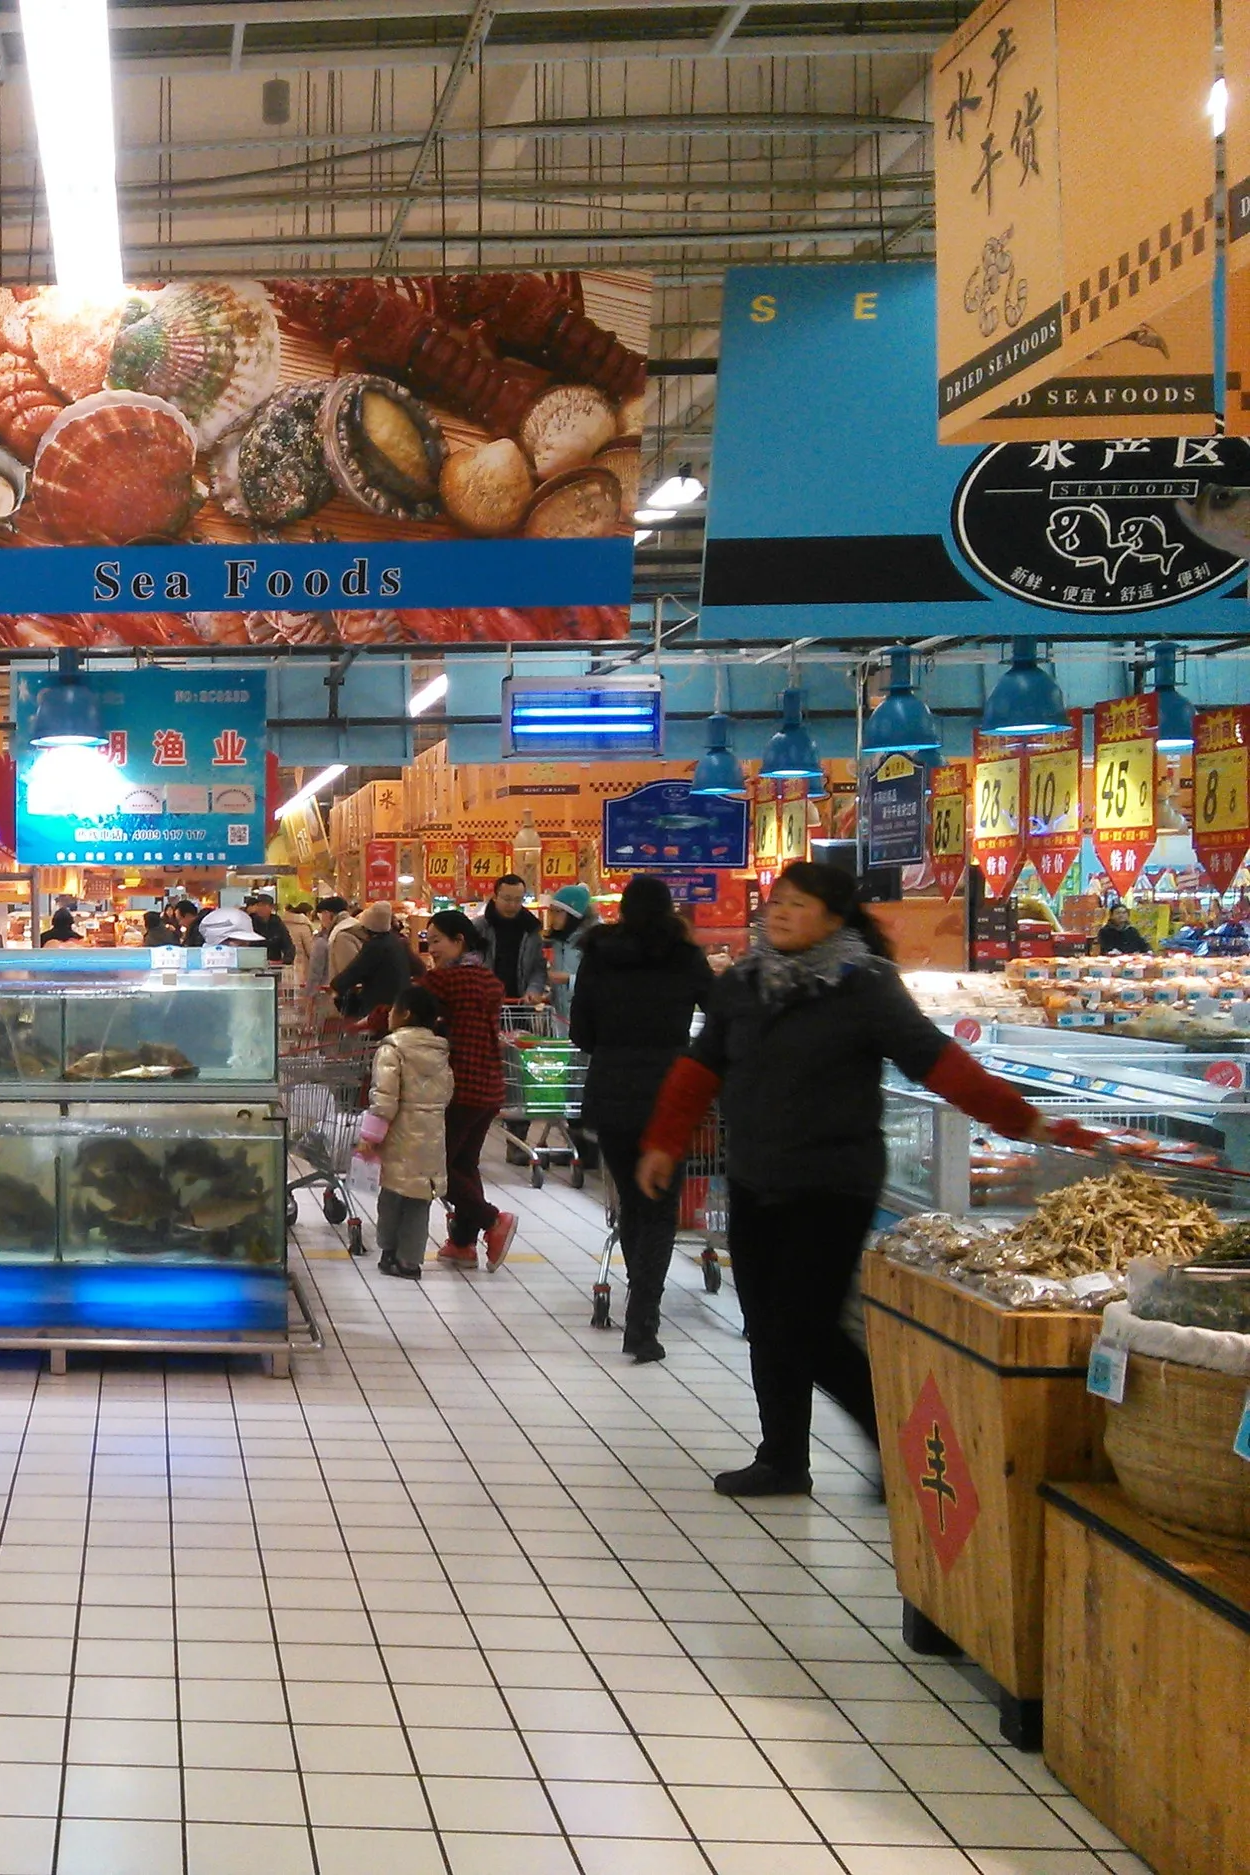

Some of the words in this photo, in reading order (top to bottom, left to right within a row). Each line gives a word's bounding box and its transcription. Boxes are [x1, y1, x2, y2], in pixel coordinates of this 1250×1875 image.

[945, 367, 984, 403] DRIED
[988, 319, 1057, 377] SEAFOODS
[1047, 386, 1196, 406] SEAFOODS
[1028, 438, 1225, 471] 水产区
[1059, 483, 1191, 497] SEAFOODS
[93, 560, 191, 601] Sea
[223, 557, 402, 599] Foods
[1102, 760, 1129, 818] 45
